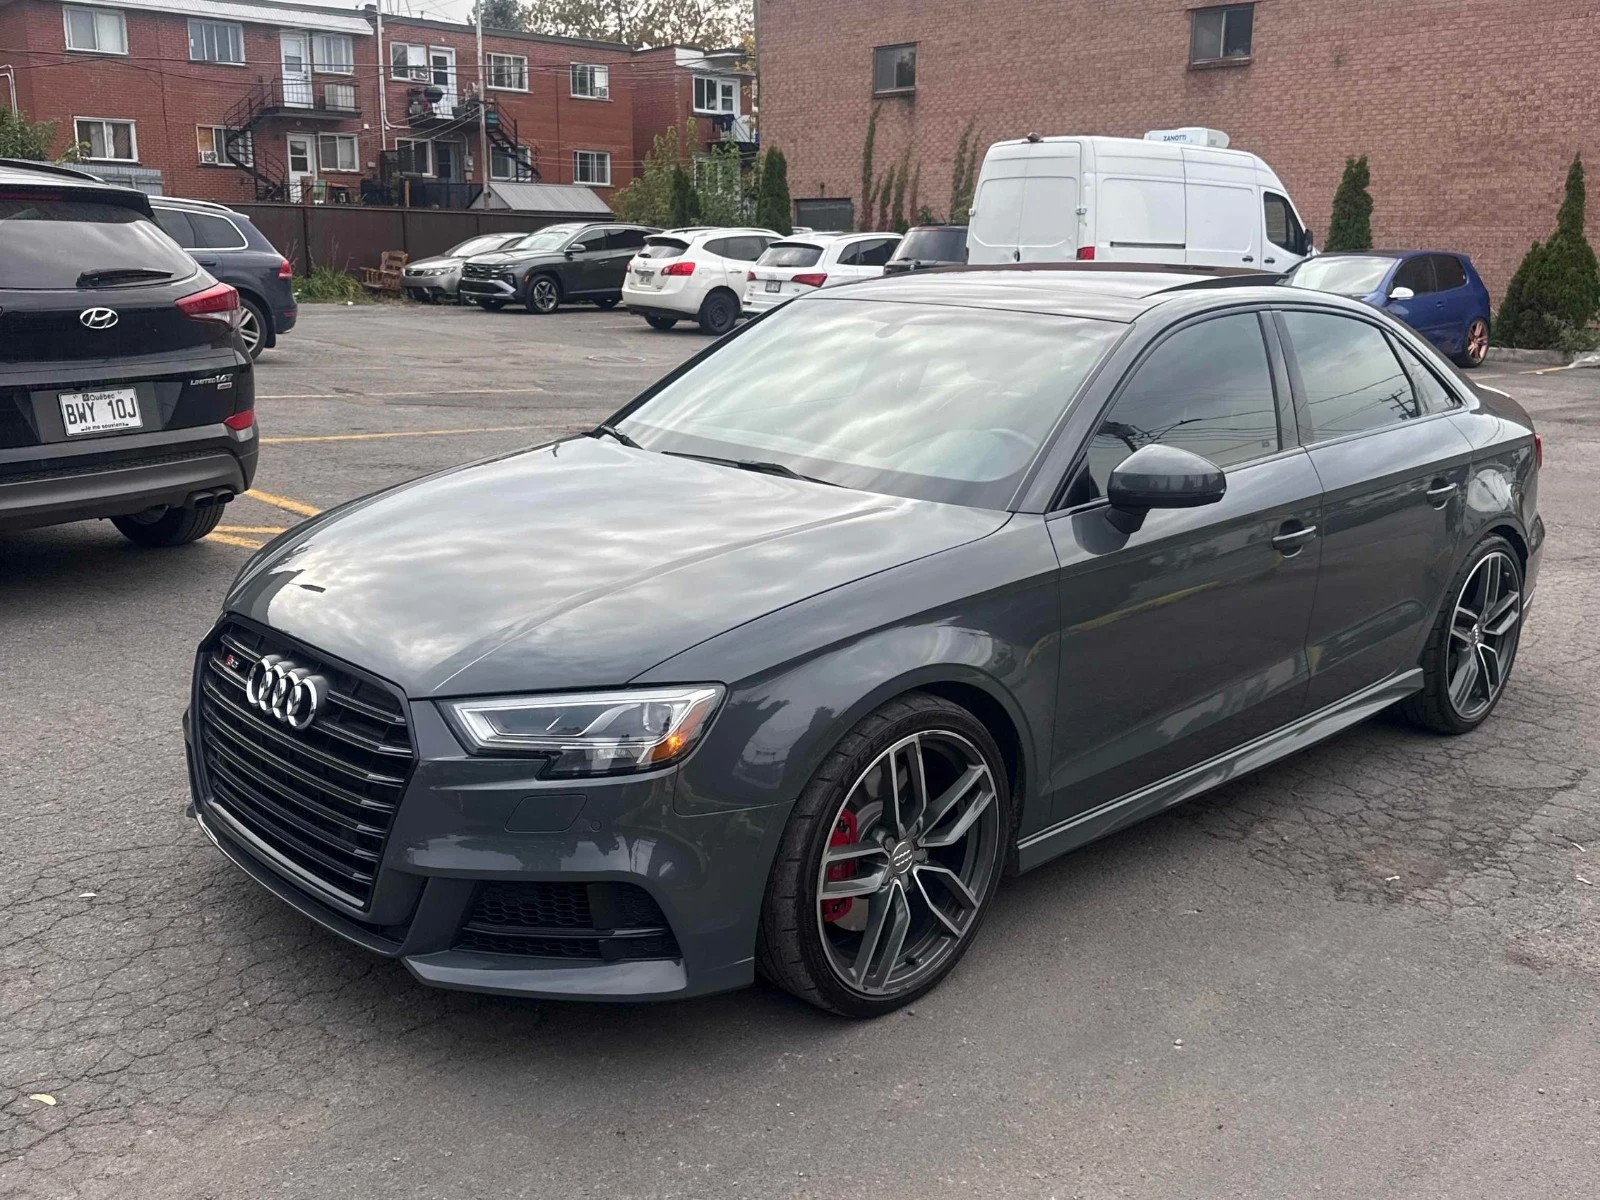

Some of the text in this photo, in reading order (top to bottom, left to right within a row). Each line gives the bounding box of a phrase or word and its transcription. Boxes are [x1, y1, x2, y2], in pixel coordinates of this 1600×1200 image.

[1163, 134, 1186, 142] ZANOTTI
[89, 393, 116, 401] Québec
[65, 397, 137, 425] BWY 10J
